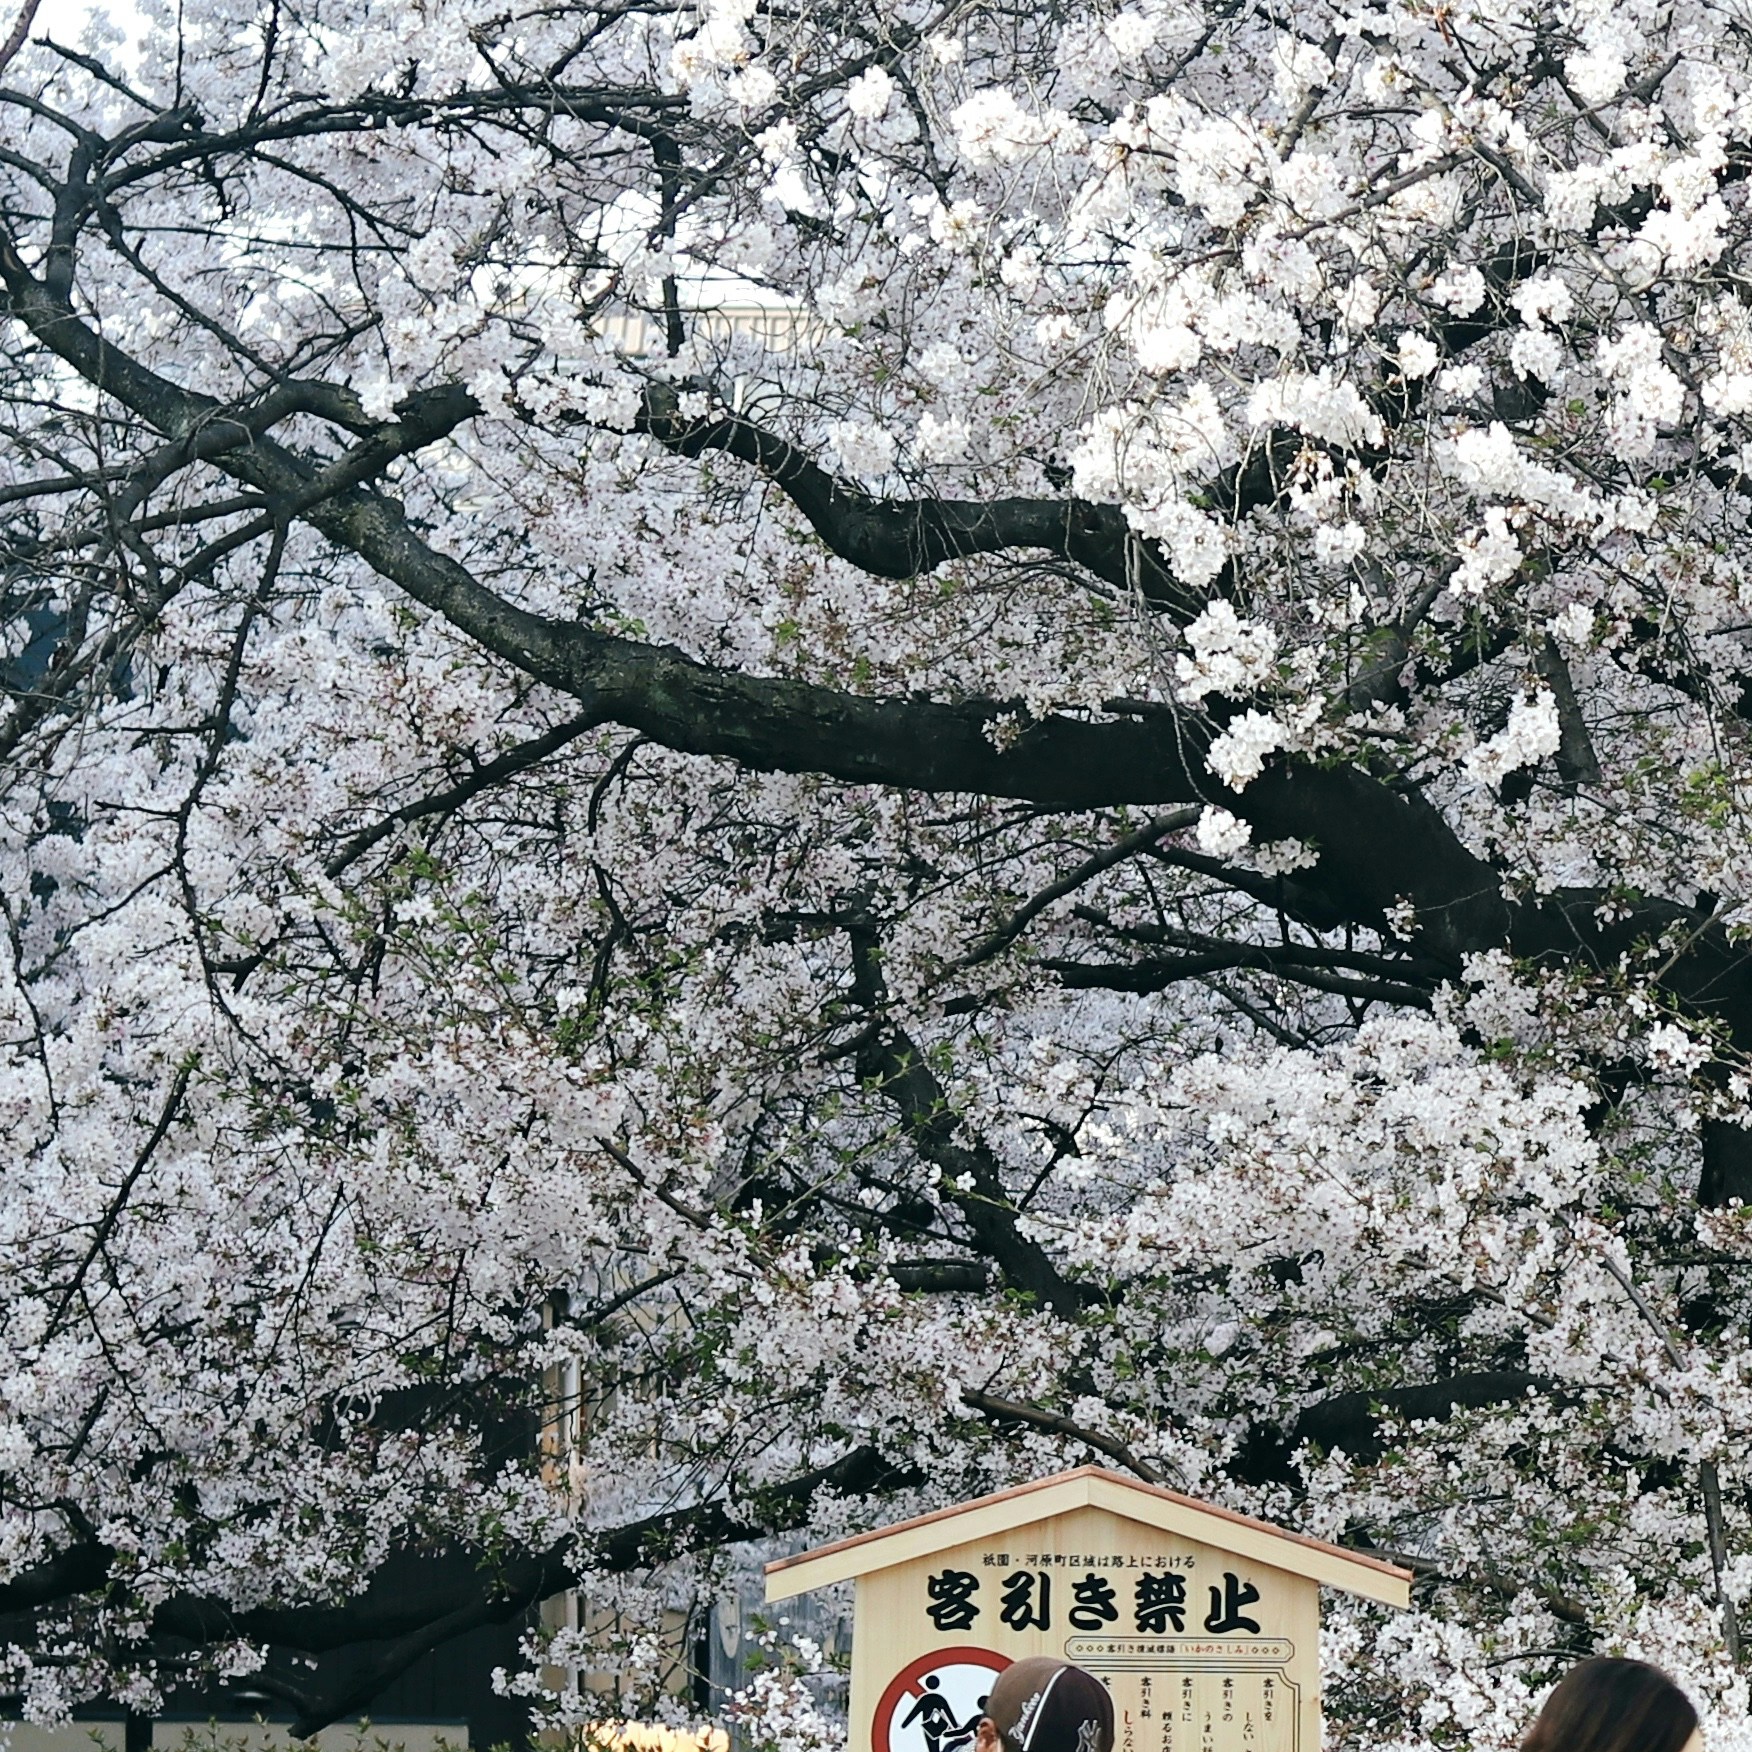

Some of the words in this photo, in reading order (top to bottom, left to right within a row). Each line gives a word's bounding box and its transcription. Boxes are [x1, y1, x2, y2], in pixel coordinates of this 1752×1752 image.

[926, 1569, 1261, 1634] 客引き禁止
[1140, 1676, 1152, 1718] 客引き料
[1181, 1677, 1193, 1722] 客引きに
[1222, 1677, 1233, 1722] 客引きの
[1263, 1677, 1275, 1722] 客引きを
